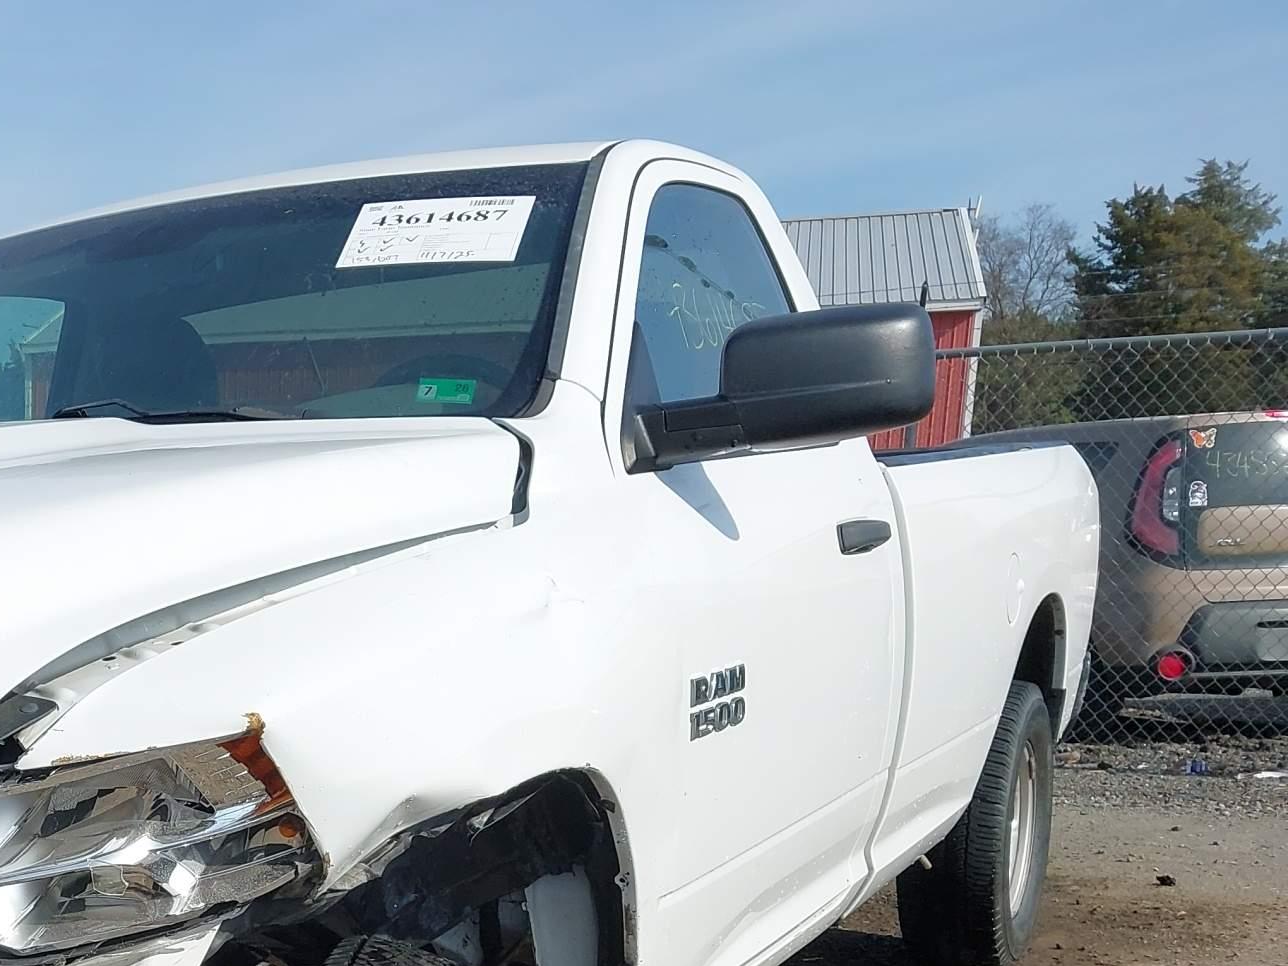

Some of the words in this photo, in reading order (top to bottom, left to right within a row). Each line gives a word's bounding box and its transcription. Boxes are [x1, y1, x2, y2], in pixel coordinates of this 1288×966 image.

[372, 209, 509, 227] 43614687
[423, 386, 433, 396] 7
[690, 663, 746, 708] RAM
[690, 696, 746, 742] 1500
